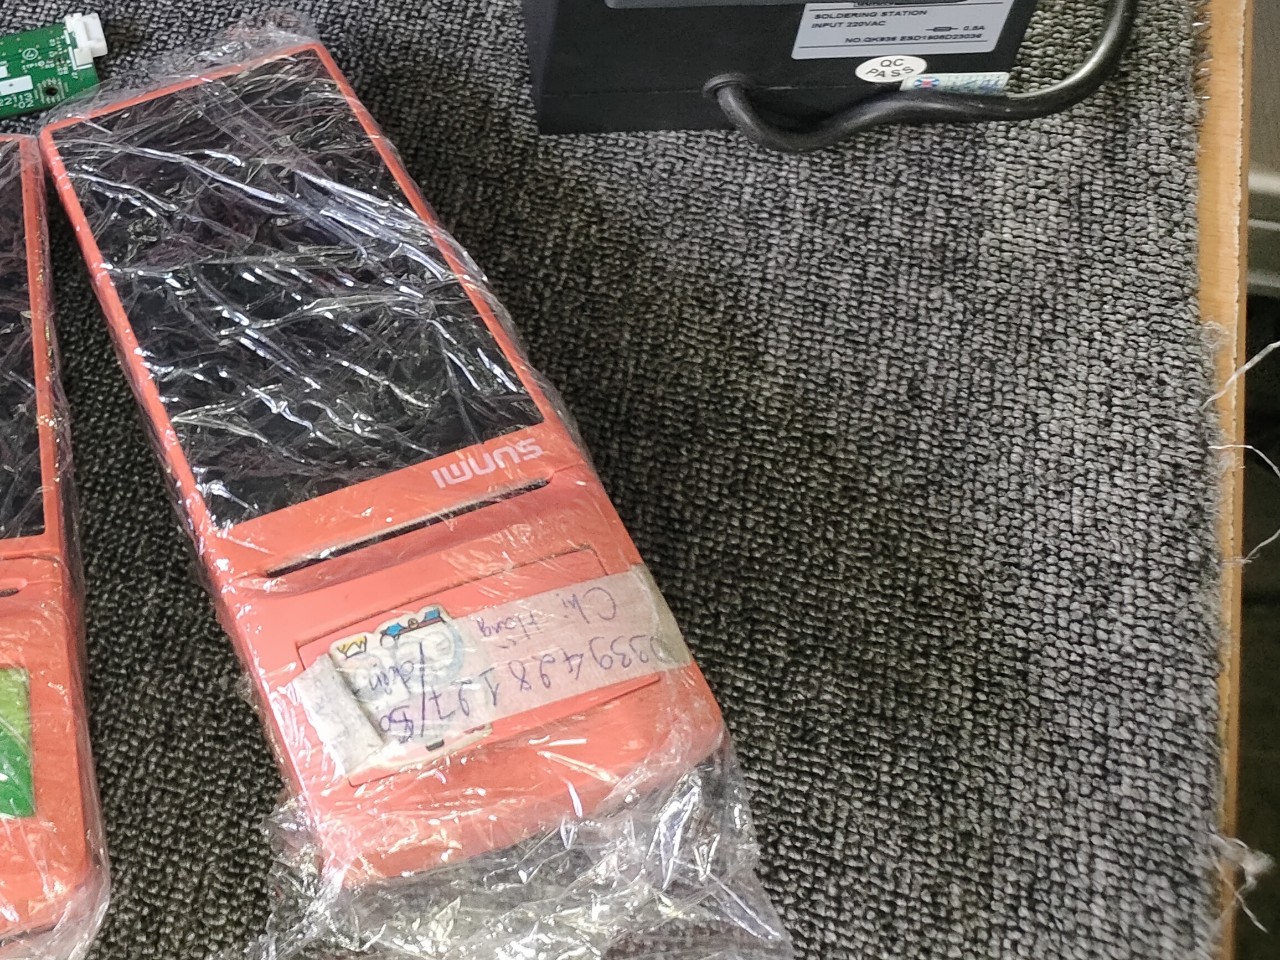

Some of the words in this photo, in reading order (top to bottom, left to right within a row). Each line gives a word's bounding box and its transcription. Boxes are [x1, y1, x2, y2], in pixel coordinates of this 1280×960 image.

[814, 11, 878, 20] SOLDERING
[880, 9, 928, 18] STATION
[811, 21, 844, 29] INPUT
[846, 20, 887, 28] 220VAC
[879, 58, 905, 68] QC
[865, 66, 915, 78] PASS
